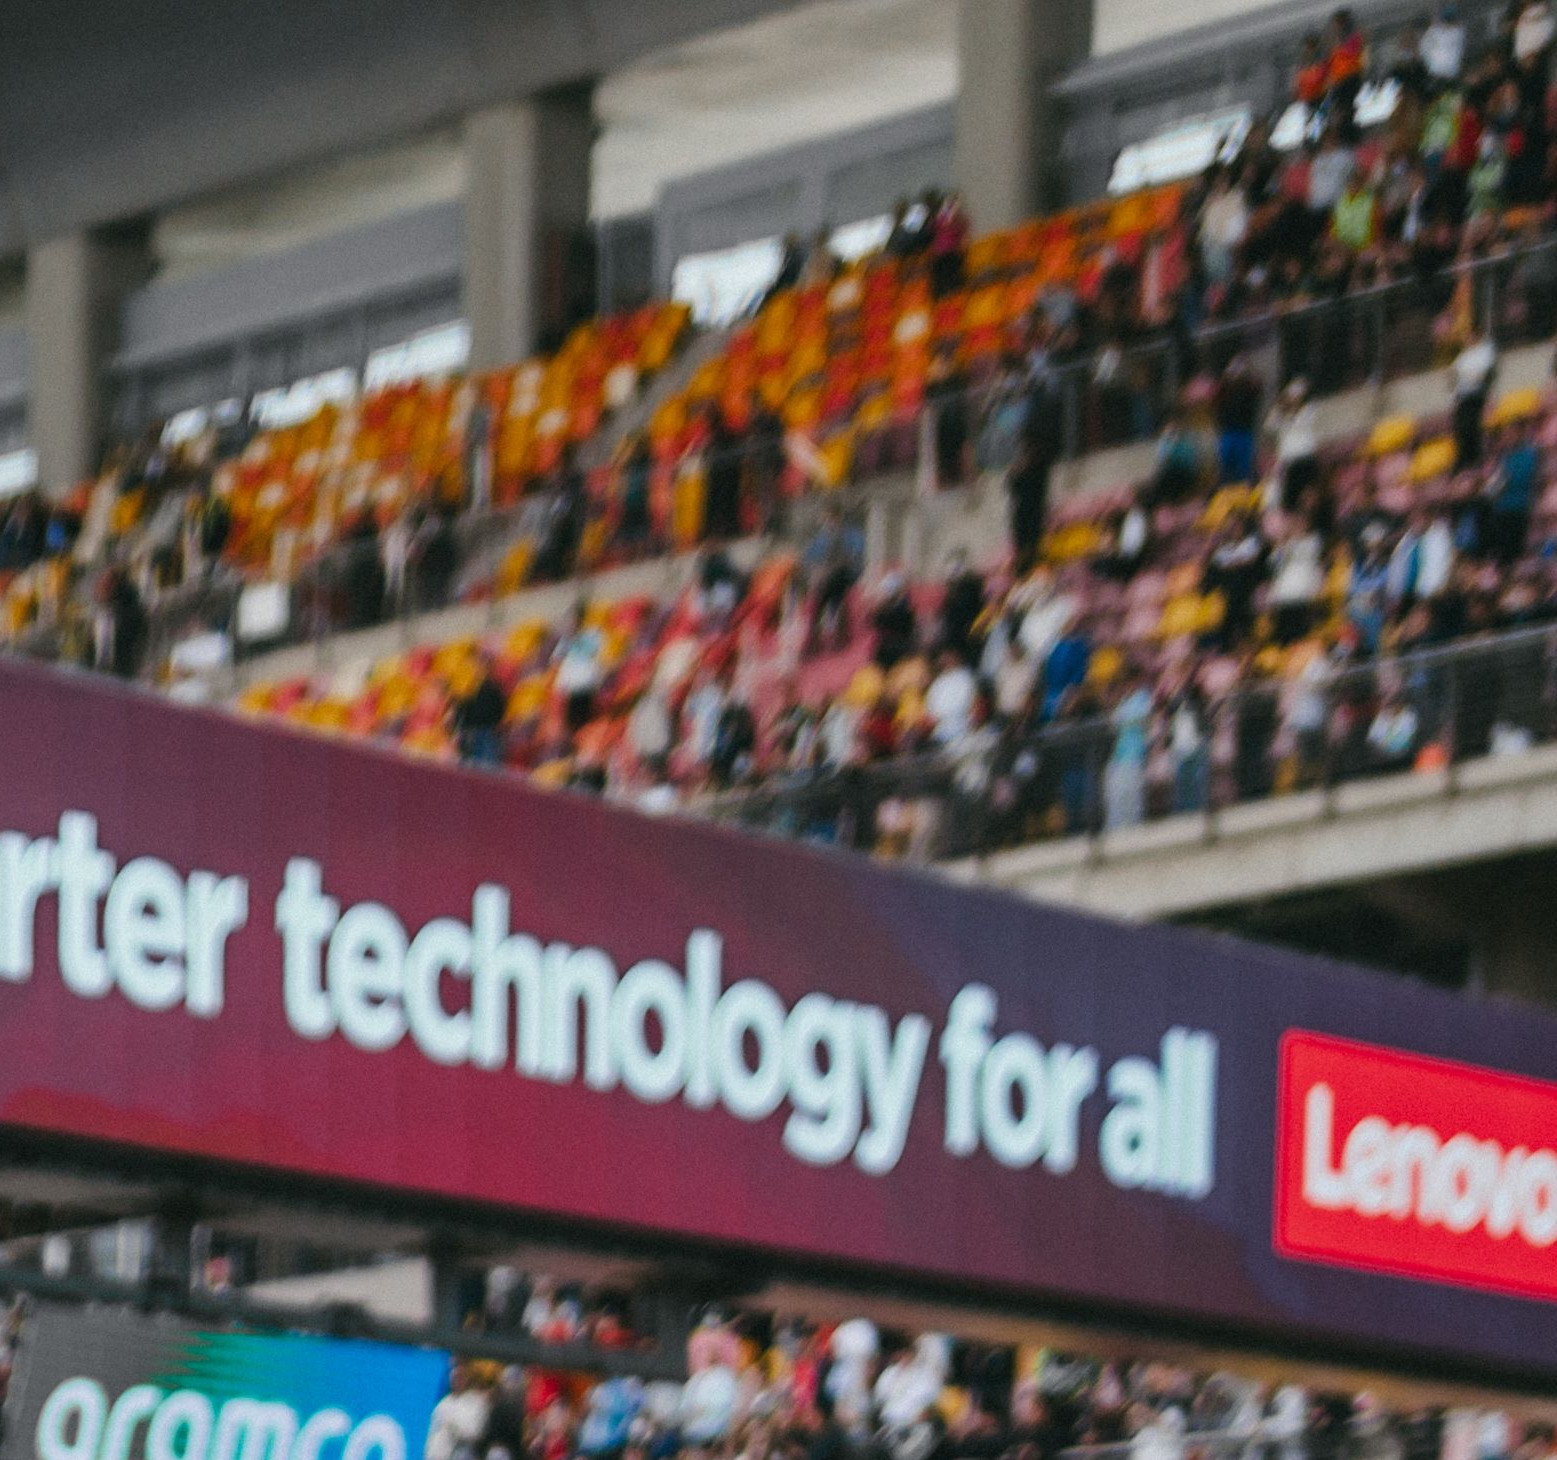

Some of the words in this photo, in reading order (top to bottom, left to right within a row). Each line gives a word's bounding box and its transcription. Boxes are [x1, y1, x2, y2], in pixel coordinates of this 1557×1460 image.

[273, 857, 931, 1176] technology
[940, 980, 1099, 1176] for
[1098, 1024, 1218, 1200] all
[1303, 1080, 1557, 1250] Lenovo
